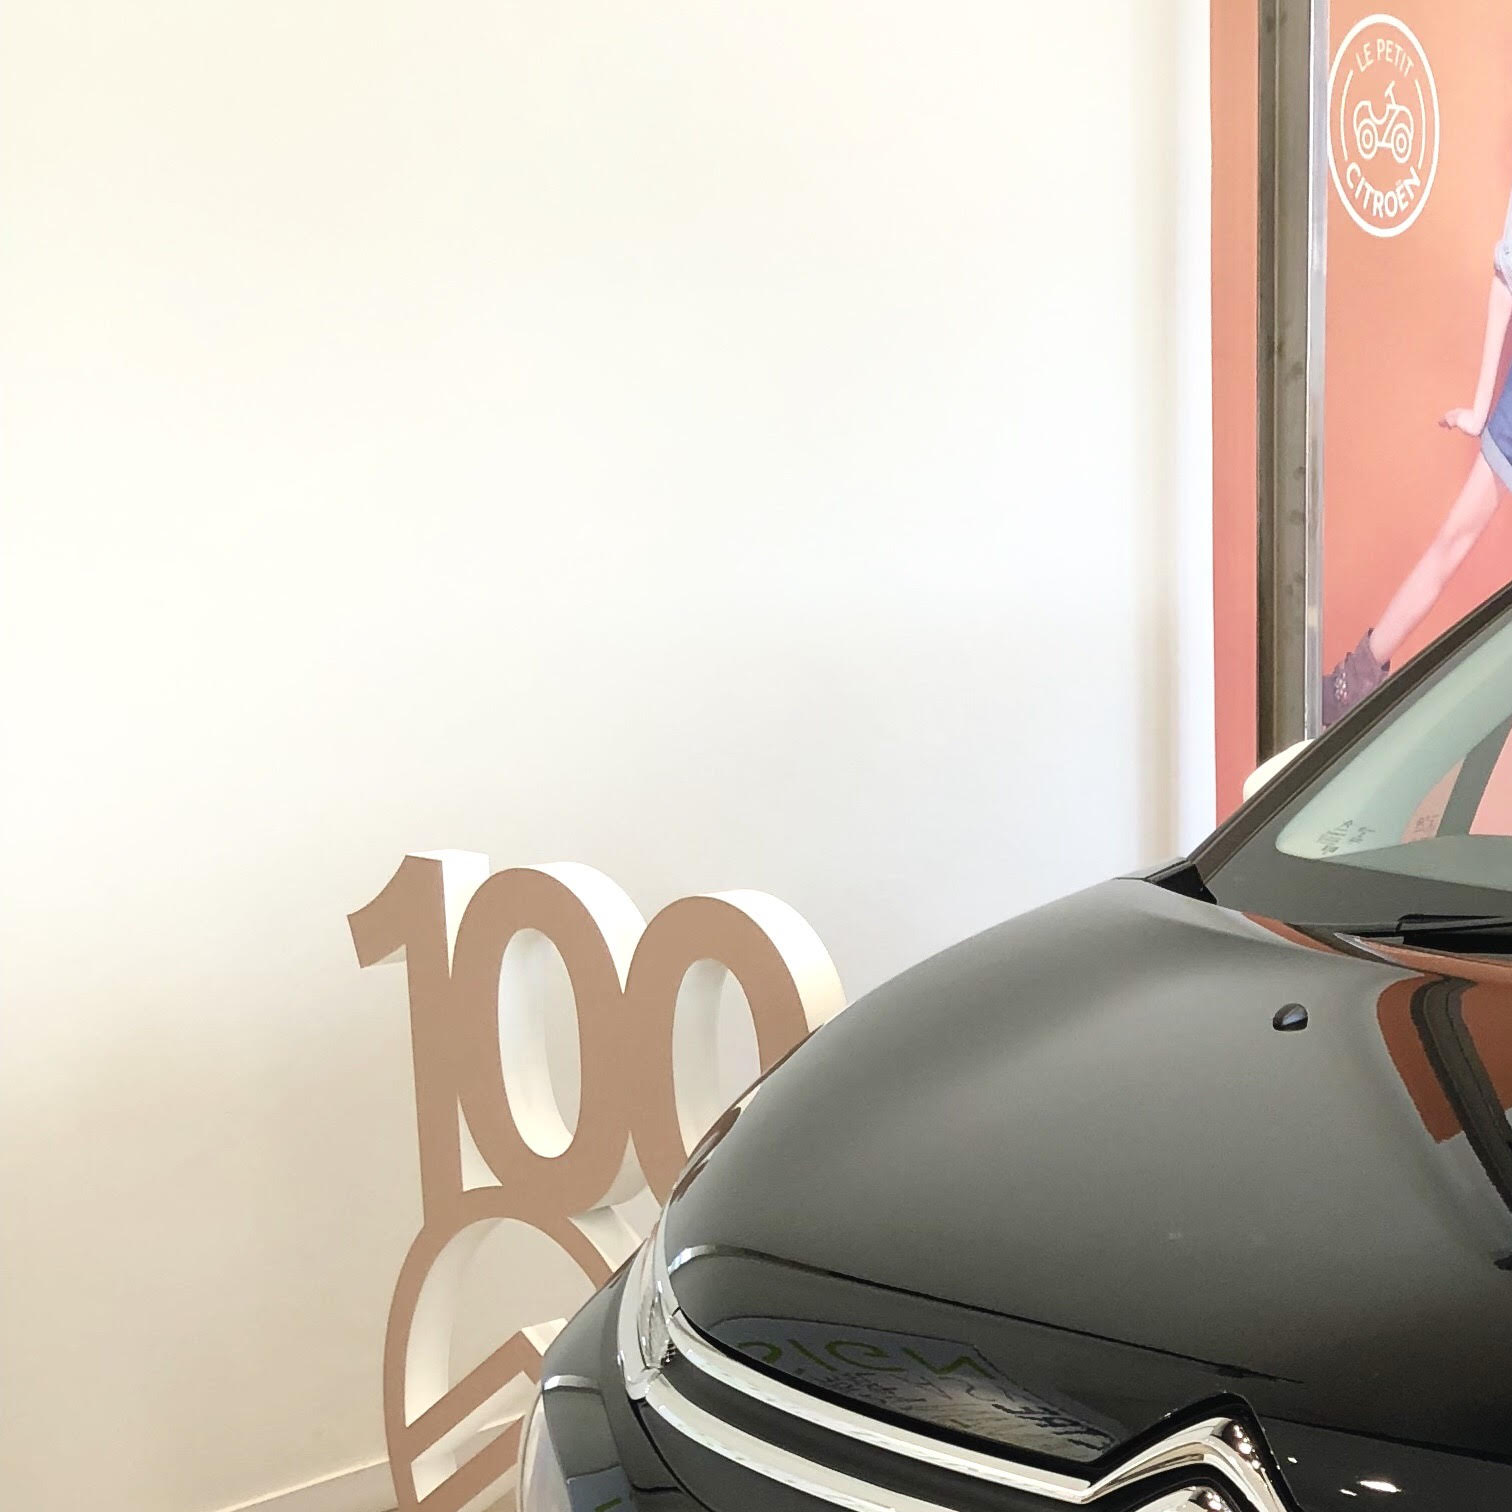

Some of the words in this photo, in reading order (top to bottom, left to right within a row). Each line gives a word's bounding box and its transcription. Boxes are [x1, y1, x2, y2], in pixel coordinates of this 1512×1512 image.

[1355, 42, 1374, 73] LE
[1376, 38, 1415, 78] PETIT
[1345, 161, 1422, 218] CITROËN
[346, 853, 822, 1210] 100
